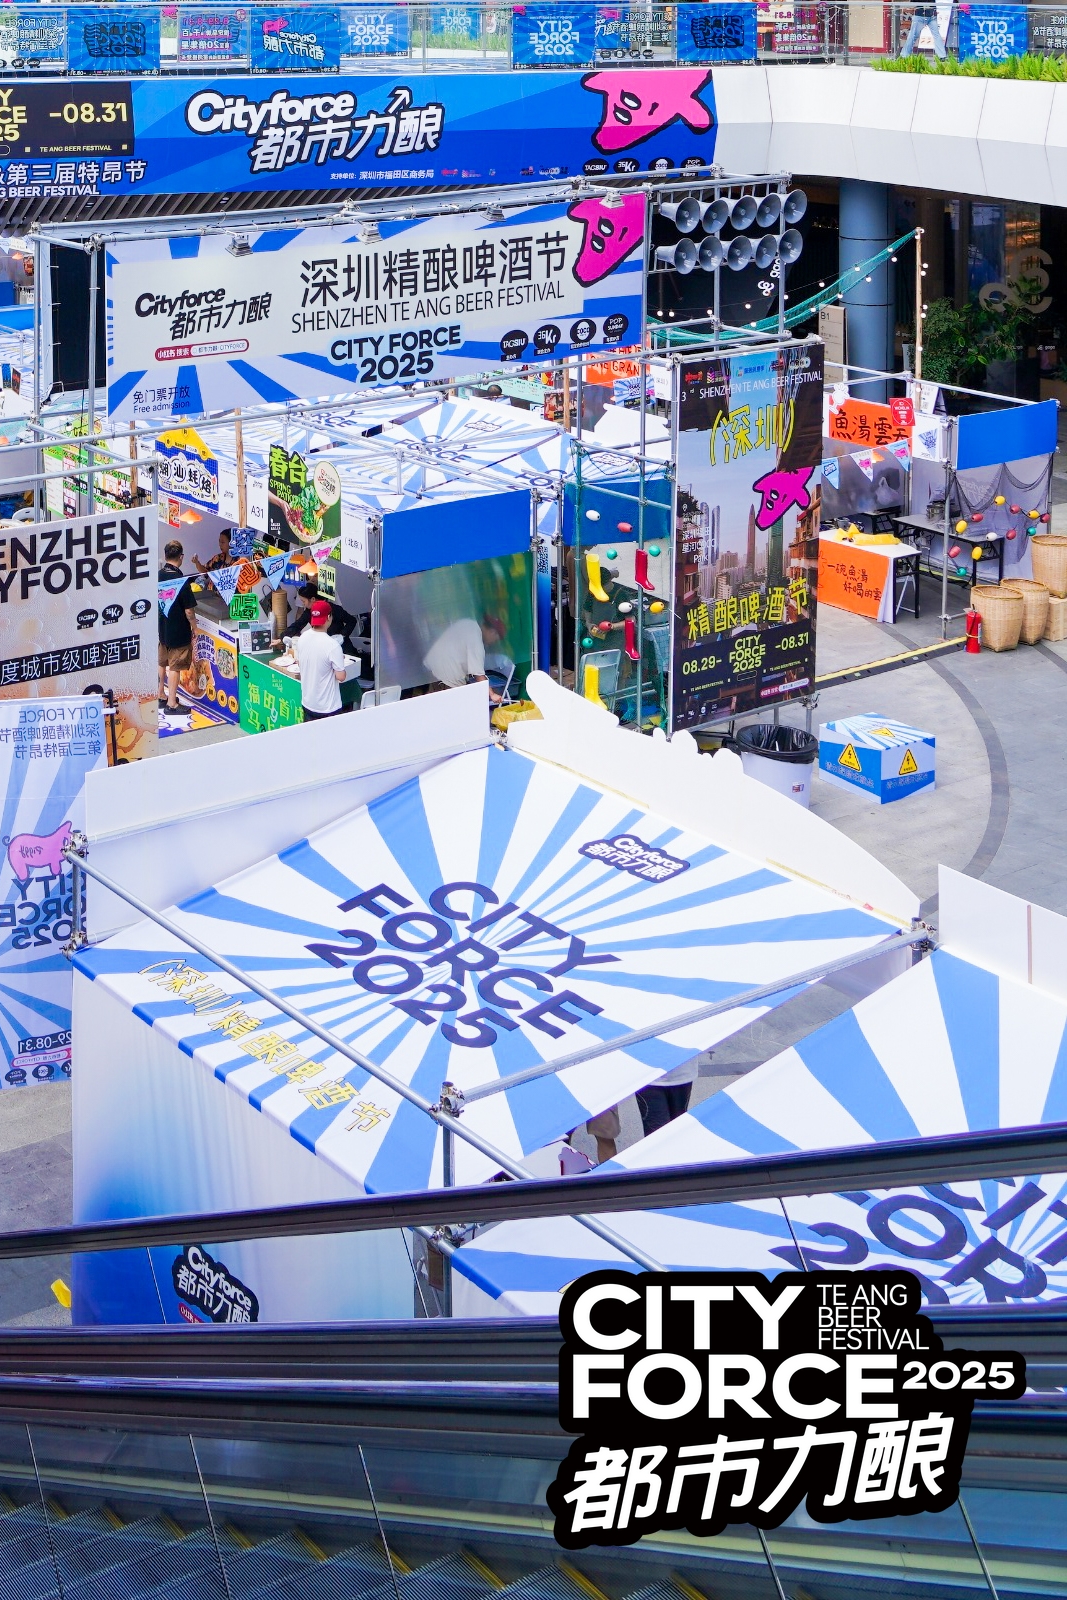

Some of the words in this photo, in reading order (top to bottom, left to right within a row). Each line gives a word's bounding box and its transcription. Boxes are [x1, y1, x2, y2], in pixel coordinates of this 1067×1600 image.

[347, 24, 394, 36] FORCE
[354, 14, 387, 25] CITY
[352, 34, 390, 46] 2025
[49, 102, 129, 125] -08.31
[187, 91, 355, 135] Cityforce
[250, 105, 443, 172] 都市力酿
[358, 168, 435, 181] 深圳市福田区商务局
[8, 186, 41, 198] BEER
[43, 184, 100, 197] FESTIVAL
[298, 230, 569, 309] 深圳精酿啤酒节
[135, 287, 226, 319] Cityforce
[169, 291, 272, 341] 都市力酿
[291, 303, 388, 334] SHENZHEN
[390, 301, 410, 322] TE
[414, 295, 452, 319] ANG
[455, 290, 493, 314] BEER
[497, 279, 566, 309] FESTIVAL
[330, 335, 385, 361] CITY
[389, 324, 461, 354] FORCE
[359, 350, 435, 384] 2025
[133, 385, 191, 403] 免门票开放
[699, 382, 742, 398] SHENZHEN
[770, 375, 790, 388] BEER
[790, 369, 823, 384] FESTIVAL
[133, 404, 159, 413] Free
[161, 399, 191, 411] admission
[270, 479, 291, 495] SPRING
[686, 576, 808, 641] 精酿啤酒节
[728, 642, 766, 664] FORCE
[734, 634, 762, 650] CITY
[774, 631, 809, 651] -08.31
[682, 654, 723, 676] 08.29-
[732, 655, 762, 674] 2025
[584, 841, 677, 881] 都市力酿
[612, 835, 687, 872] Cityforce
[428, 881, 622, 978] CITY
[336, 882, 605, 1040] FORCE
[303, 927, 521, 1049] 2025
[187, 1246, 252, 1309] Cityforce
